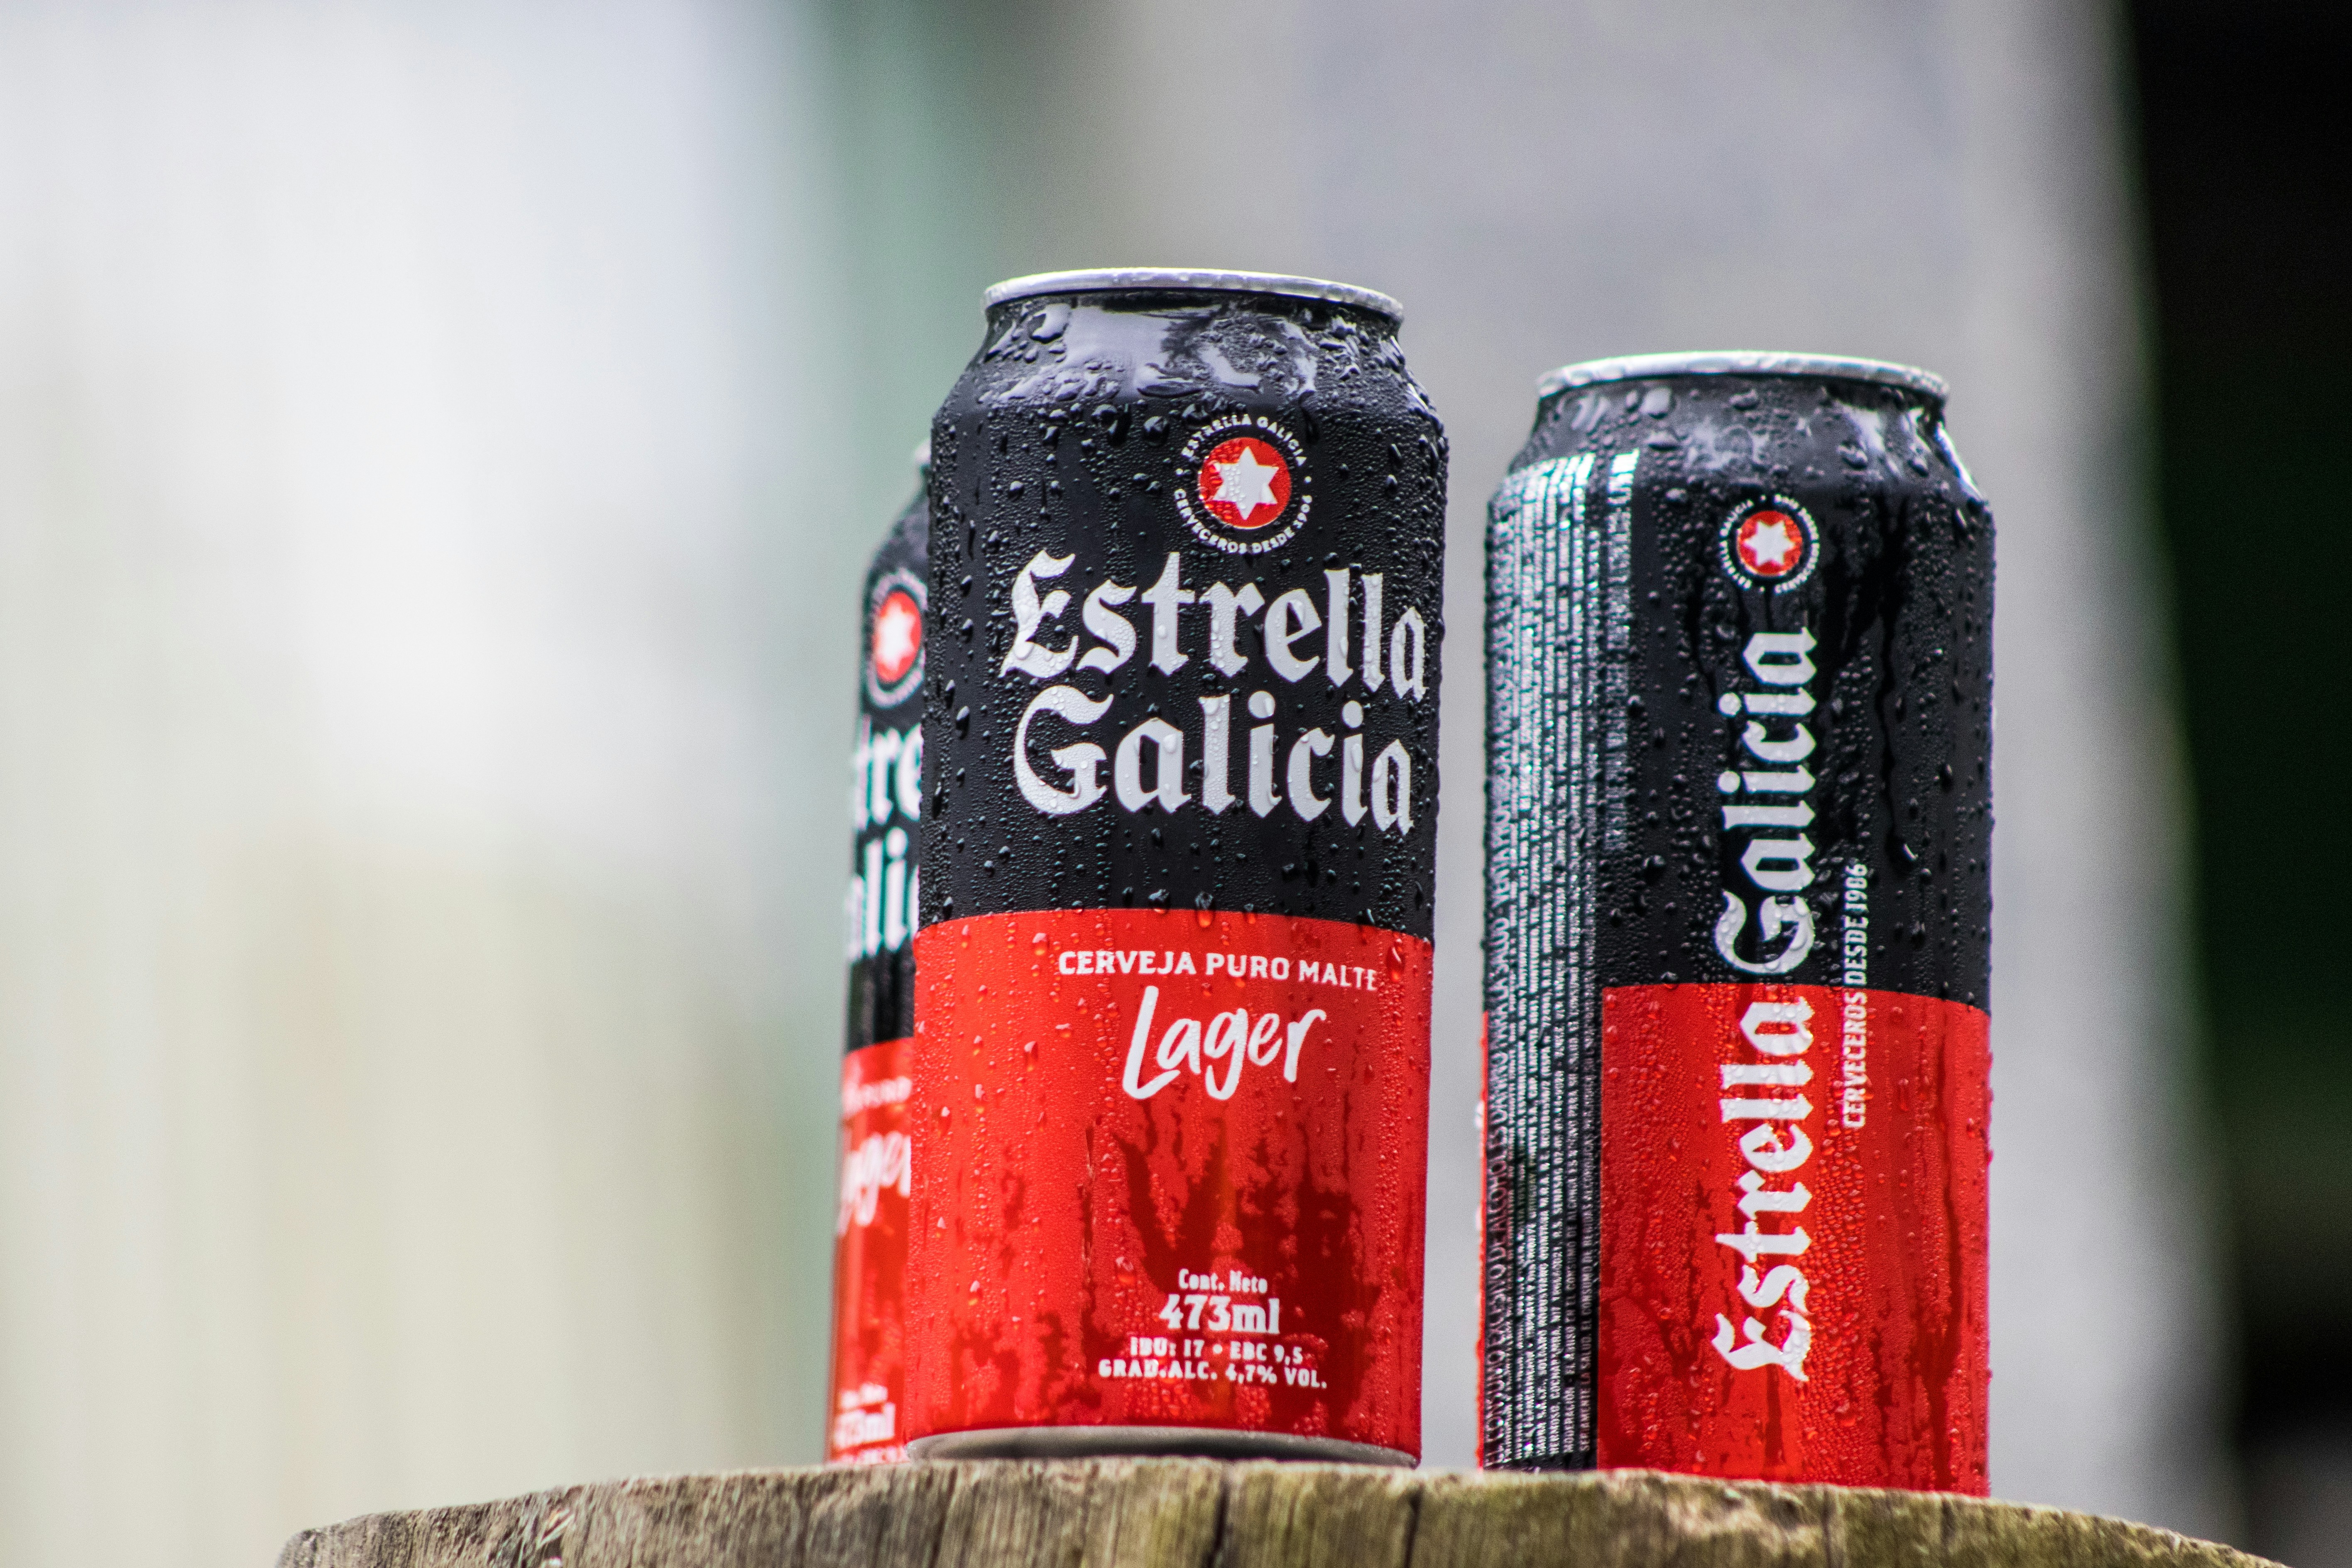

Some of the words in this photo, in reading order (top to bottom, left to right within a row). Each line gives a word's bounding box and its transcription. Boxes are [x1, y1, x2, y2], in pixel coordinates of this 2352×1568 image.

[1181, 414, 1251, 457] ESTRELLA
[1257, 416, 1307, 466] GALICIA
[1174, 488, 1247, 555] CERVECEROS
[1252, 527, 1295, 554] DESDE
[999, 550, 1427, 702] Estrella
[1013, 684, 1414, 834] Galicia
[1714, 626, 1817, 975] Galicia
[1843, 864, 1868, 911] 1906
[1059, 951, 1196, 975] CERVEJA
[1206, 953, 1290, 981] PURO
[1298, 959, 1378, 991] MALTE
[1843, 916, 1868, 985] DESDE
[1122, 986, 1327, 1101] Lager
[1843, 992, 1867, 1128] CERVECEROS
[1711, 996, 1815, 1381] Estrella
[1159, 1294, 1280, 1334] 473ml
[1178, 1268, 1225, 1292] Cont.
[1229, 1270, 1268, 1294] Neto
[1184, 1339, 1205, 1358] 17
[1273, 1345, 1303, 1365] 9,5
[1225, 1363, 1278, 1385] 4,7%
[1284, 1366, 1327, 1389] VOL.
